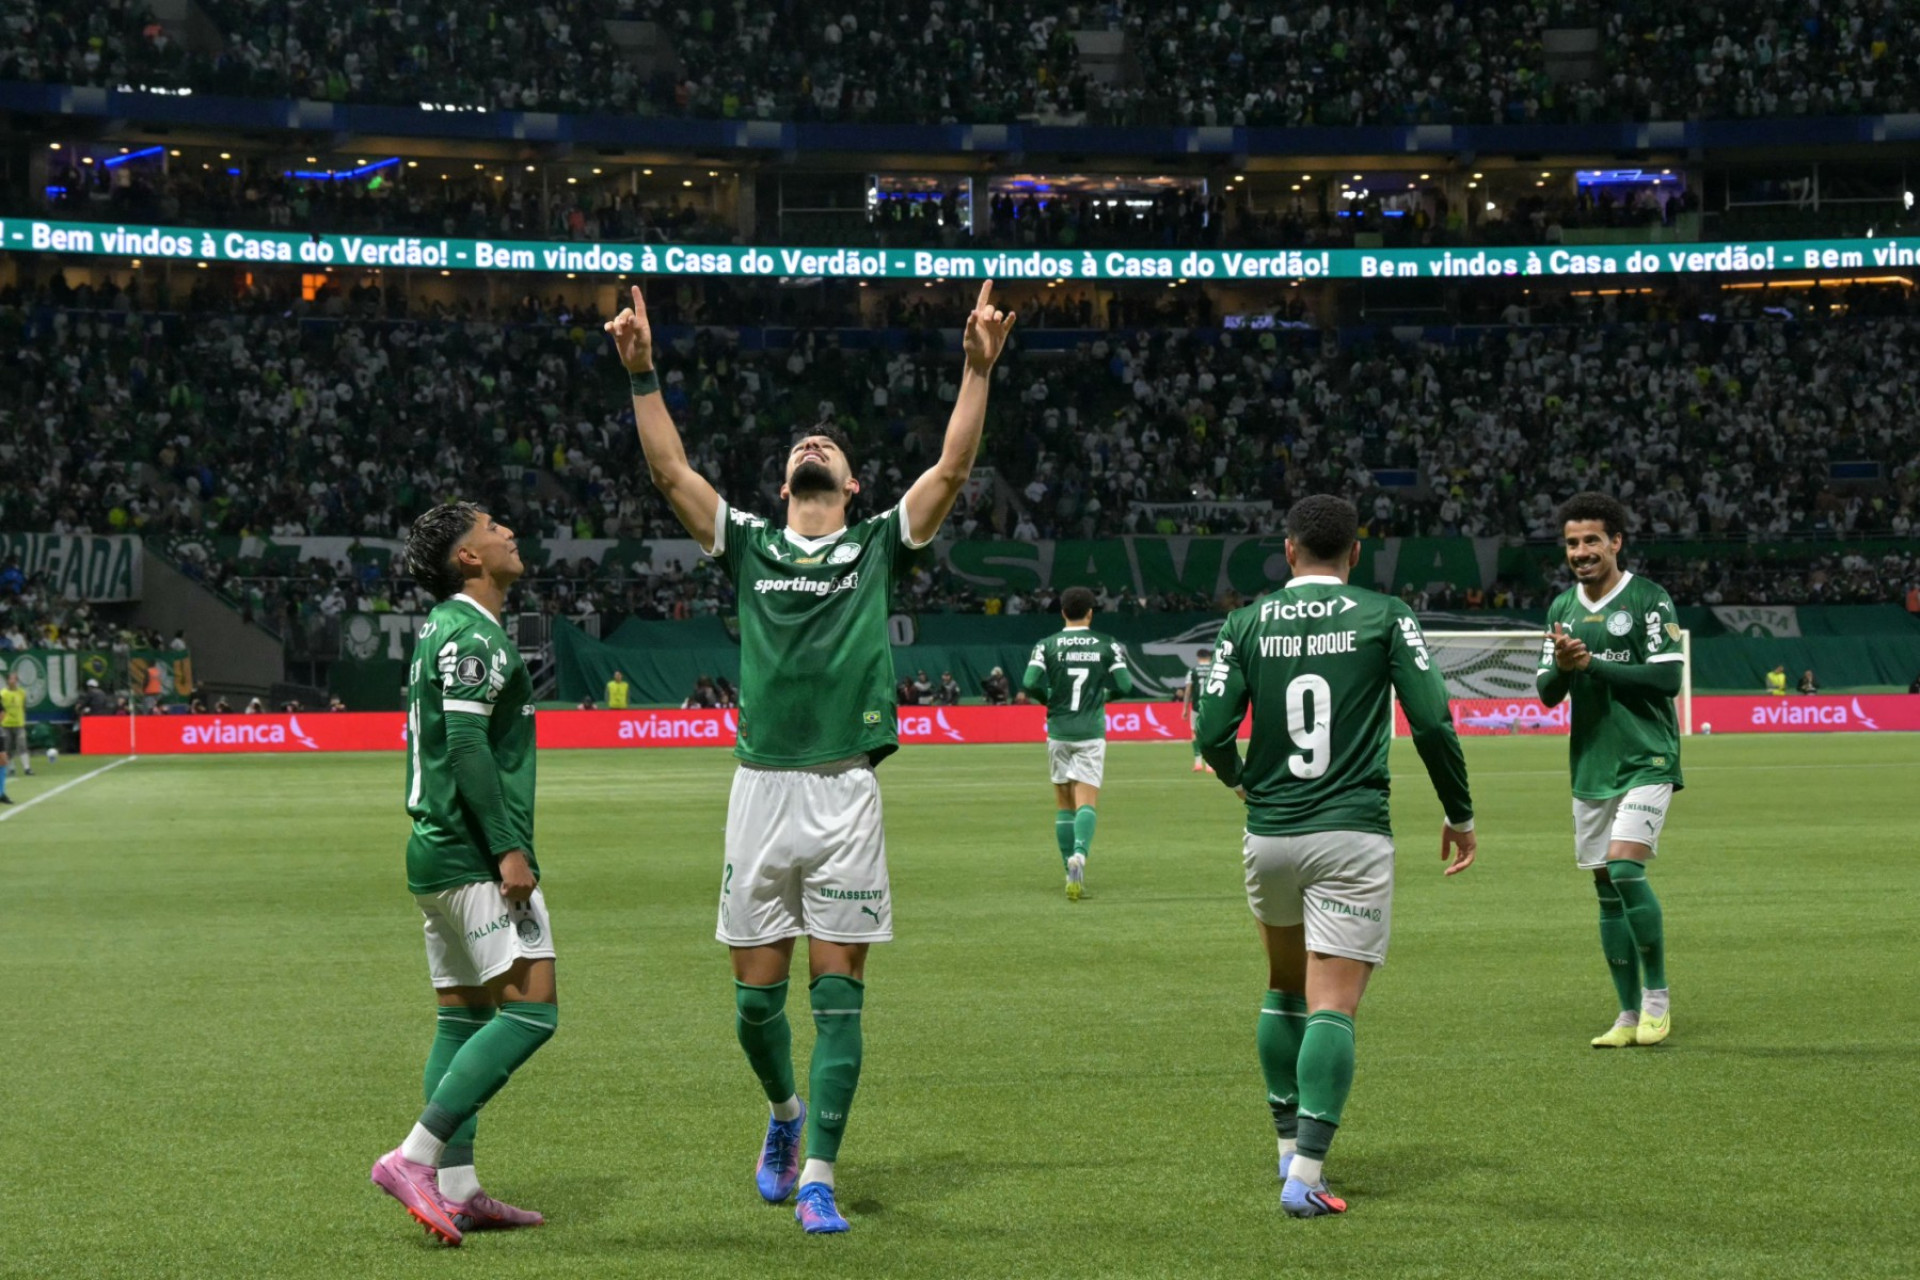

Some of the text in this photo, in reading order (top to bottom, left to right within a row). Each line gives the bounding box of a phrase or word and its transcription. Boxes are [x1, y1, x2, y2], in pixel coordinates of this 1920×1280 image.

[33, 222, 93, 252] Bem
[101, 227, 192, 257] vindos
[200, 232, 217, 258] à
[224, 232, 291, 261] Casa
[301, 237, 333, 263] do
[341, 237, 448, 268] Verdão!
[475, 242, 534, 269] Bem
[543, 245, 633, 272] vindos
[641, 245, 658, 272] à
[665, 247, 732, 274] Casa
[739, 248, 774, 274] do
[781, 249, 887, 276] Verdão!
[914, 251, 975, 277] Bem
[983, 252, 1073, 278] vindos
[1081, 251, 1098, 277] à
[1105, 252, 1173, 277] Casa
[1180, 251, 1215, 278] do
[1222, 252, 1329, 277] Verdão!
[1361, 256, 1418, 278] Bem
[1429, 251, 1518, 276] vindos
[1526, 251, 1542, 275] à
[1549, 250, 1617, 275] Casa
[1625, 250, 1660, 273] do
[1668, 245, 1775, 272] Verdão!
[1804, 249, 1863, 268] Bem
[754, 572, 858, 596] sportingbet
[1260, 598, 1337, 623] Fictor
[1057, 636, 1092, 647] Fictor
[1259, 631, 1357, 657] VITOR ROQUE
[1065, 651, 1101, 662] ANDERSON
[1067, 667, 1089, 711] 7
[1751, 700, 1848, 724] avianca
[182, 719, 285, 744] avianca
[618, 714, 719, 739] avianca
[1286, 674, 1331, 780] 9
[820, 887, 883, 900] UNIASSELVI
[465, 920, 501, 944] ITALIA
